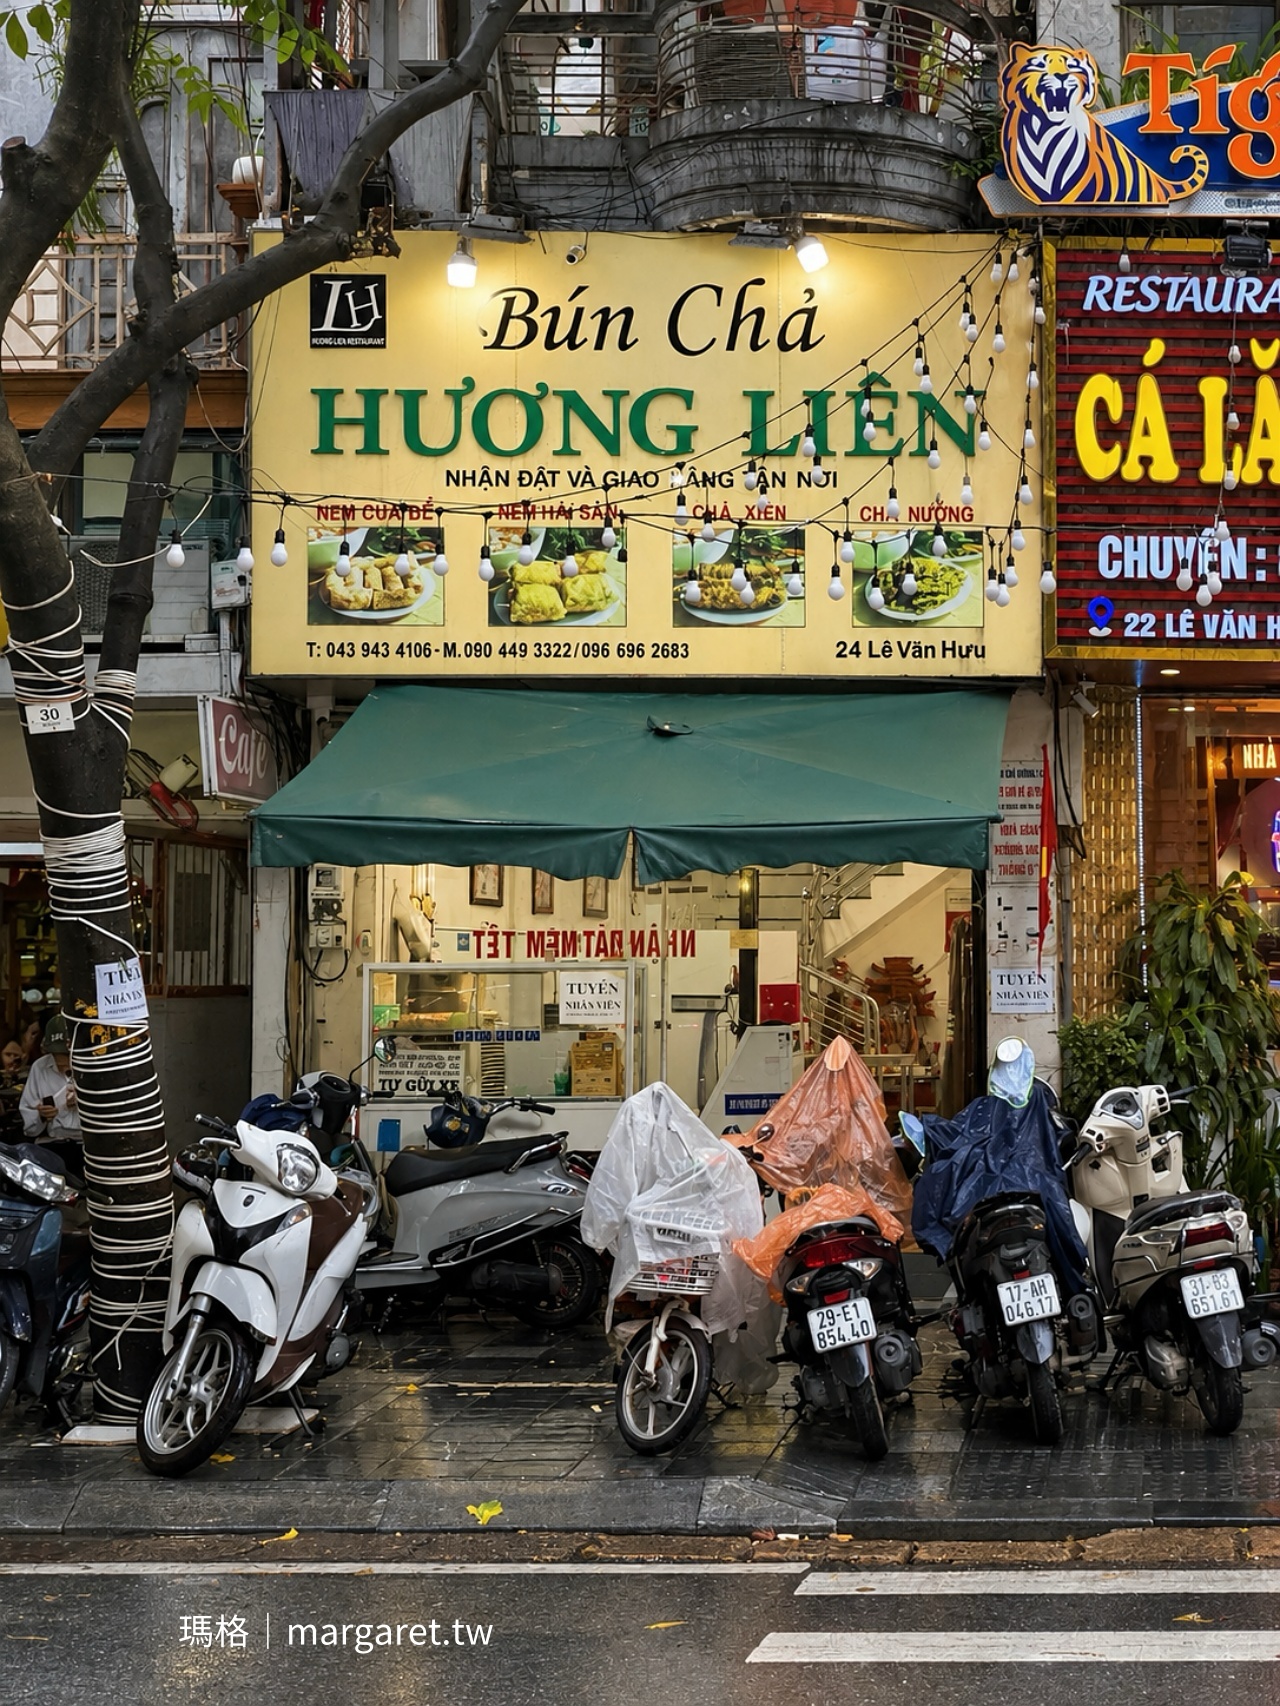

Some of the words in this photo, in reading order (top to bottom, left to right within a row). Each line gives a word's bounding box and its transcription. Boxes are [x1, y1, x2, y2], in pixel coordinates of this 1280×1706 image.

[478, 286, 639, 352] Bún
[667, 278, 826, 357] Chả
[310, 376, 699, 457] HƯƠNG
[742, 371, 987, 458] LIÊN
[1075, 338, 1181, 483] CÁ
[446, 467, 510, 490] NHẬN
[567, 465, 596, 488] VÀ
[602, 470, 660, 488] GIAO
[316, 504, 355, 521] NEM
[362, 504, 401, 521] CUA
[498, 504, 536, 520] NEM
[1124, 613, 1156, 637] 22
[1165, 609, 1195, 638] LÊ
[1203, 609, 1256, 639] VĂN
[306, 642, 321, 658] T:
[326, 642, 356, 658] 043
[361, 642, 390, 658] 943
[498, 642, 528, 658] 449
[617, 642, 645, 658] 696
[651, 642, 689, 658] 2683
[835, 641, 862, 658] 24
[868, 640, 893, 658] Lê
[897, 640, 936, 658] Văn
[40, 708, 60, 721] 30
[1242, 736, 1277, 769] NHÀ
[1005, 1279, 1048, 1303] 17-AH
[1190, 1289, 1240, 1315] 651.61
[816, 1303, 861, 1330] 29-E1
[1005, 1296, 1053, 1322] 046.17
[816, 1319, 871, 1349] 854.40
